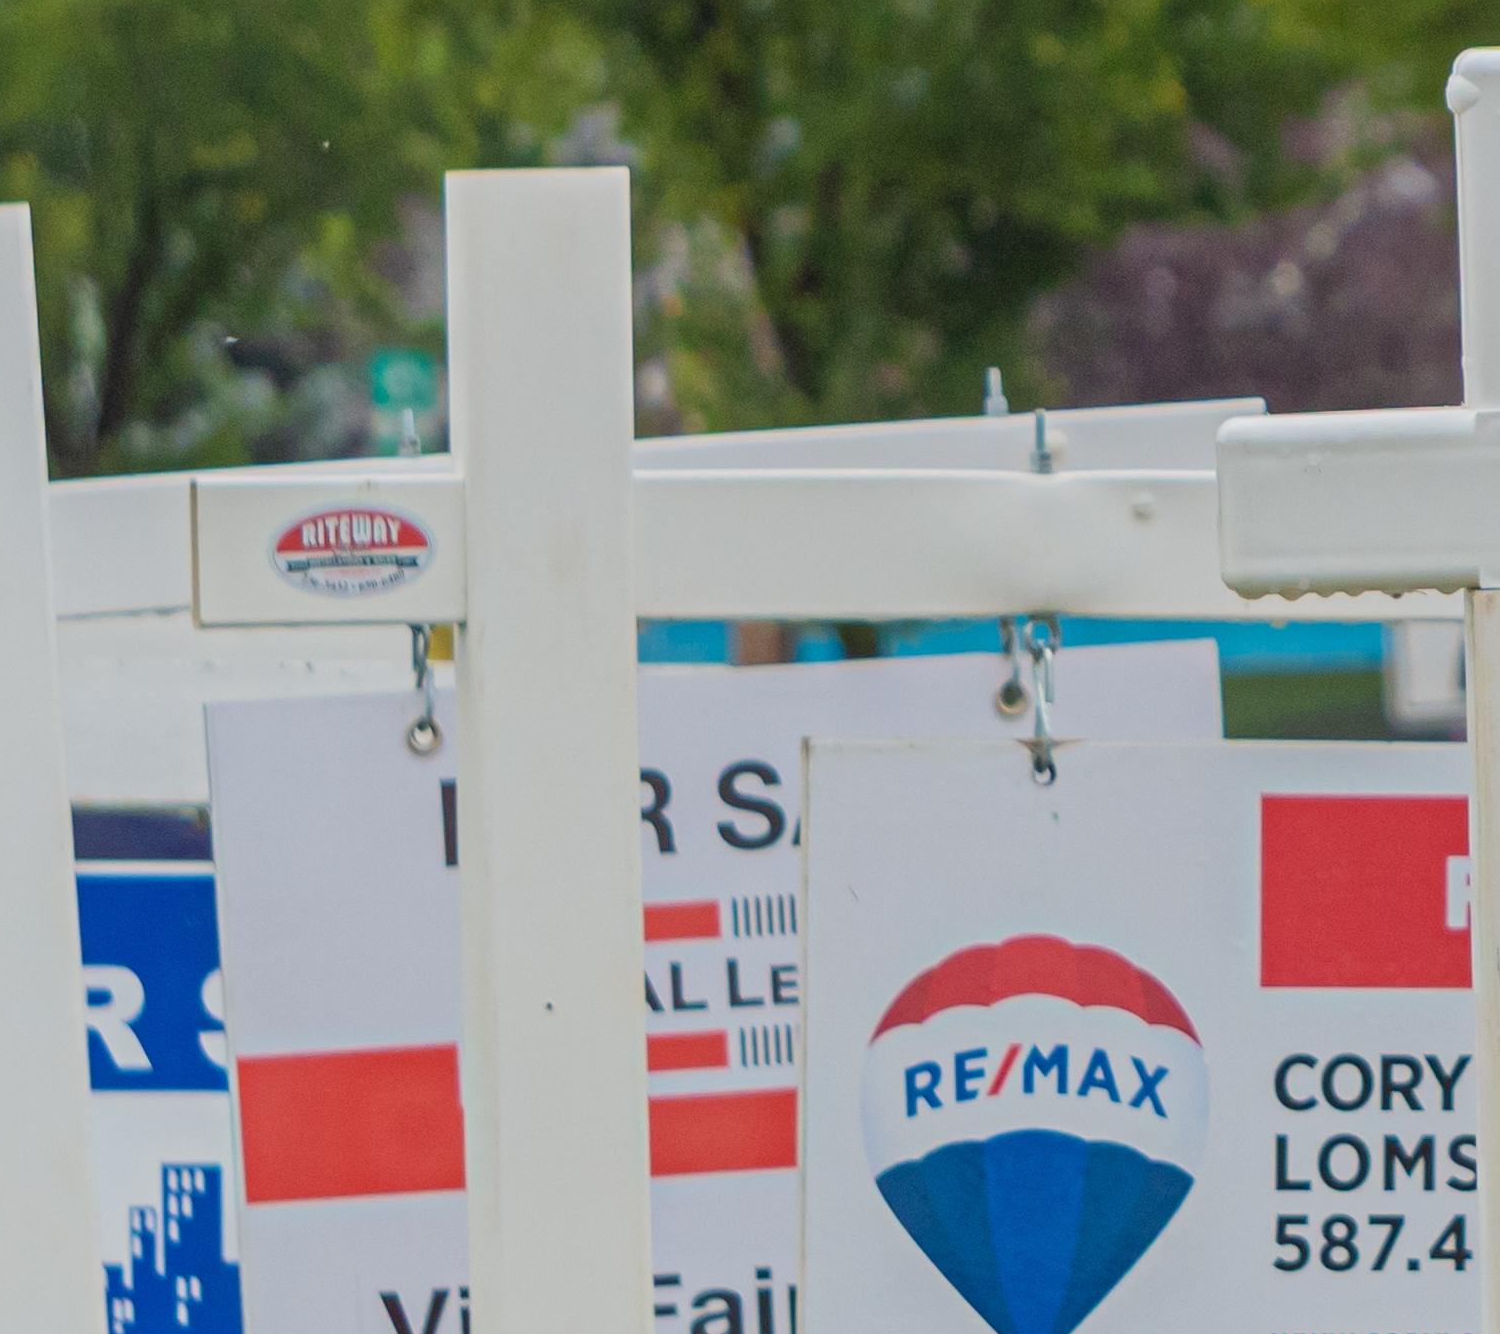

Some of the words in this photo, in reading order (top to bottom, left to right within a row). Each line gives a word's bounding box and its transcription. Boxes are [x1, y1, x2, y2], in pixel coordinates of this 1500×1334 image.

[302, 514, 400, 548] RITEWAY
[904, 1043, 1170, 1120] RE/MAX
[1273, 1053, 1472, 1111] CORY
[1273, 1133, 1478, 1192] LOMS
